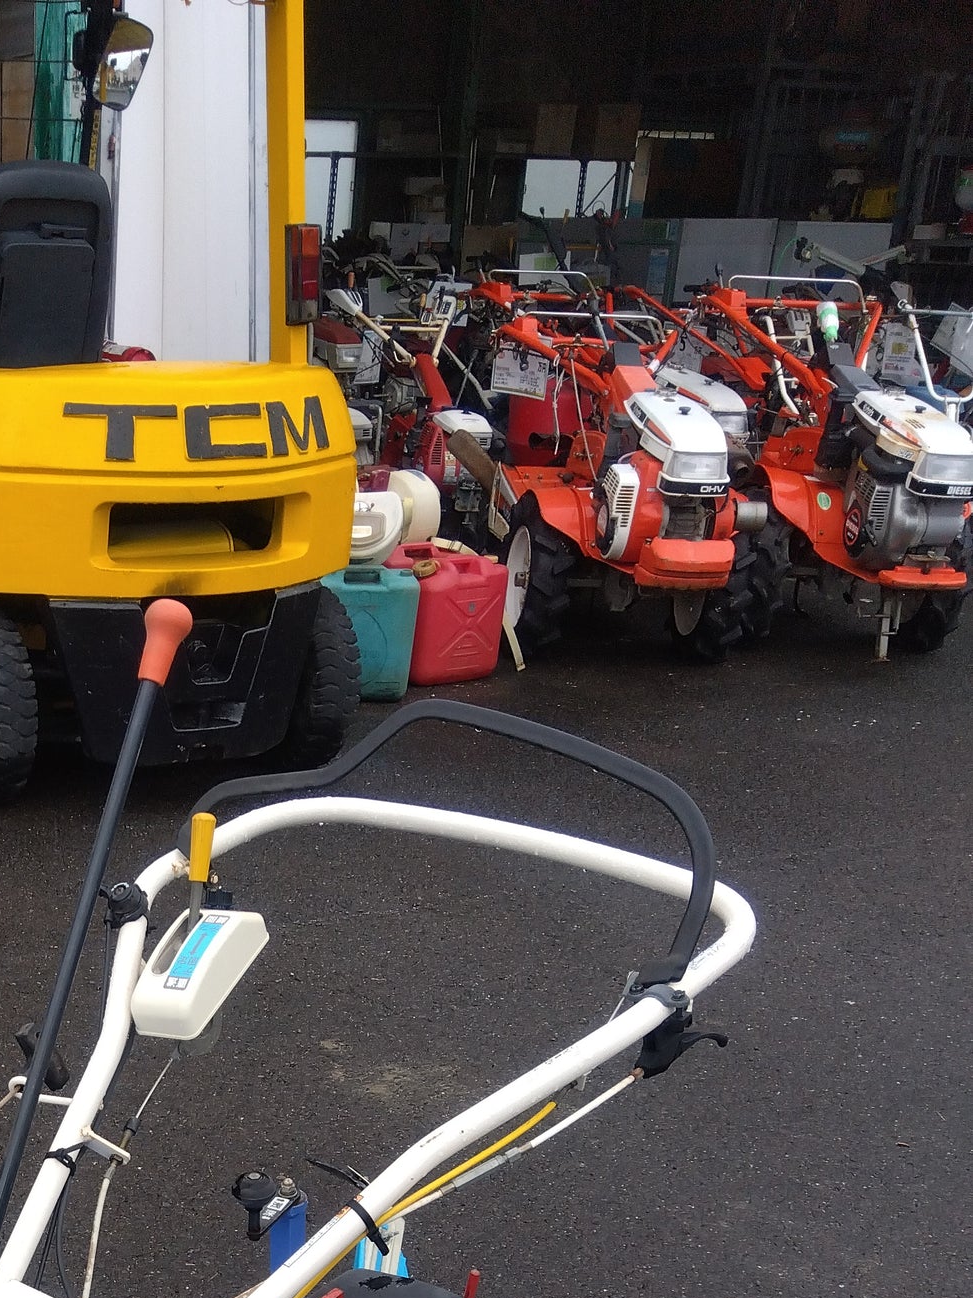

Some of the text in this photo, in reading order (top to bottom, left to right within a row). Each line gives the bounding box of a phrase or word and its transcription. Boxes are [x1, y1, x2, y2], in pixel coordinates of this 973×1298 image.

[63, 396, 329, 460] TCM
[699, 485, 725, 493] OHV
[947, 486, 973, 495] DIESEL
